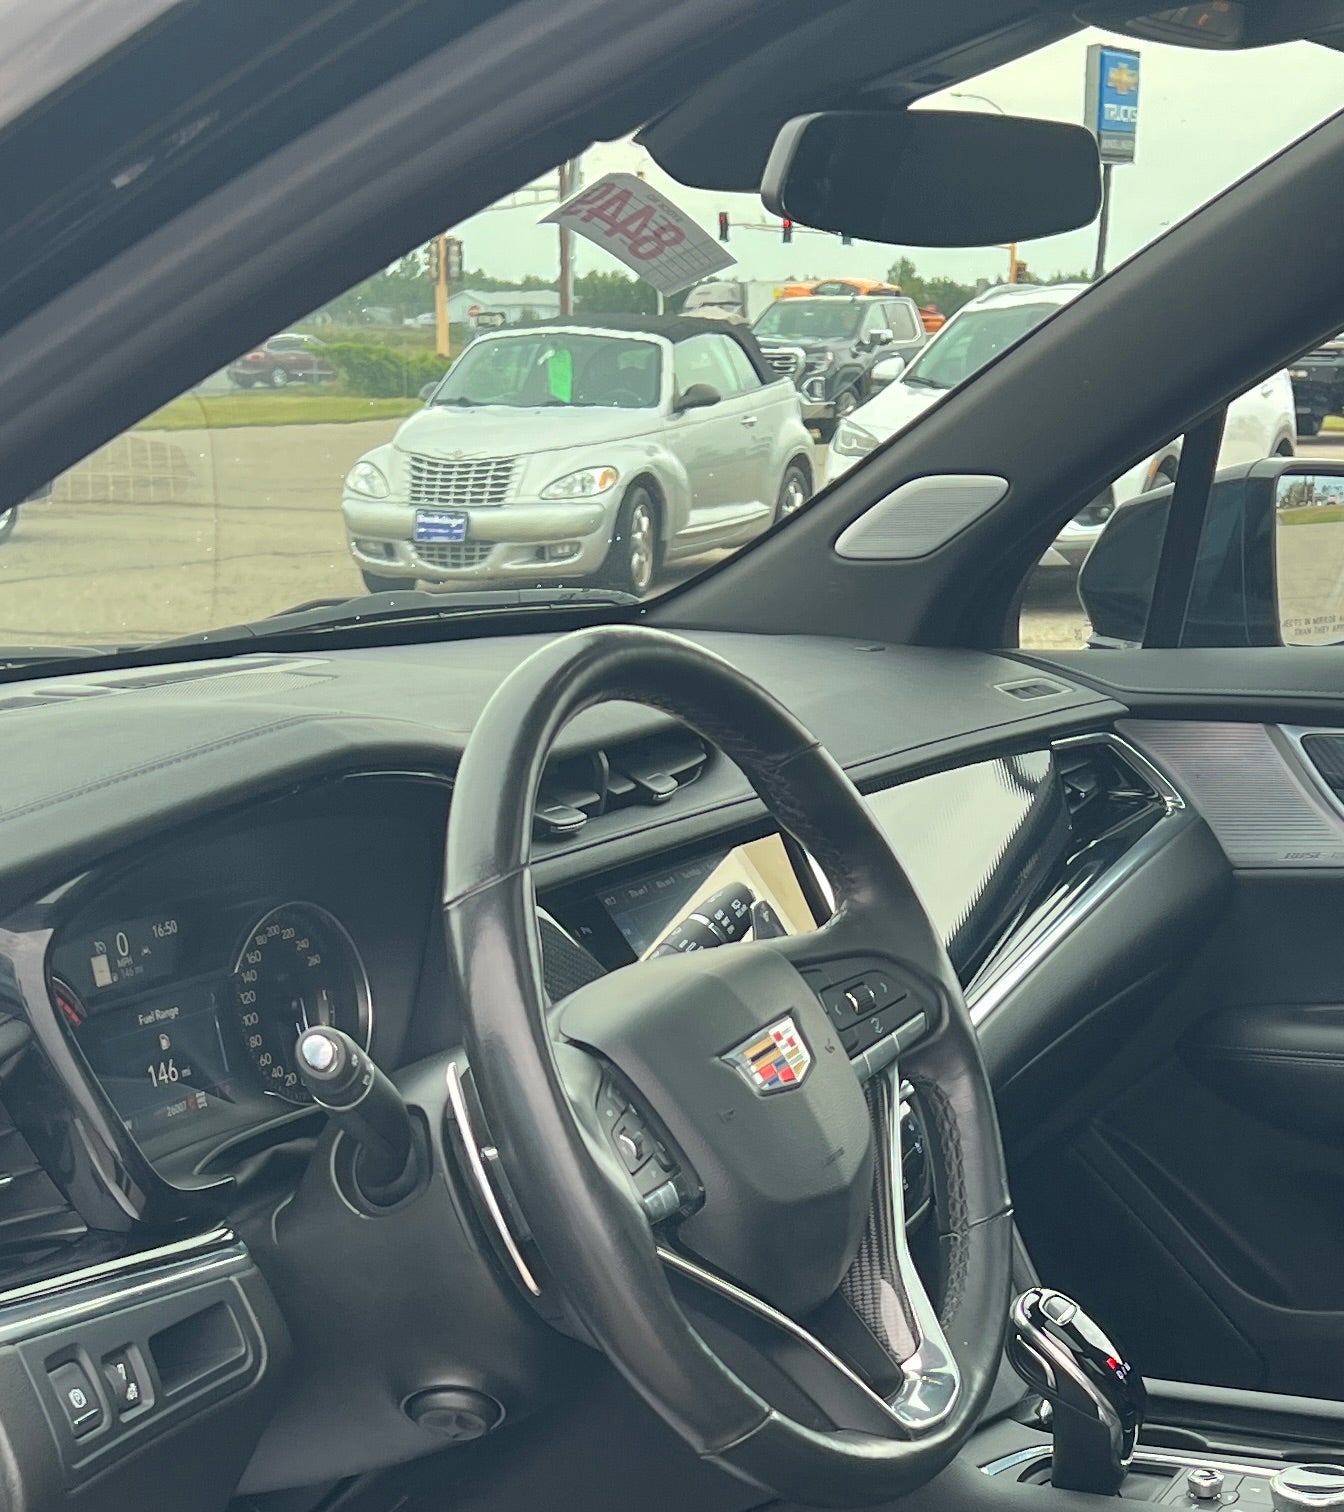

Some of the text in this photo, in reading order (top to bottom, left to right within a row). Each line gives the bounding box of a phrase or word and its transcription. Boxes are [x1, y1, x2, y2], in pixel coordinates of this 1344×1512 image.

[152, 919, 178, 938] 16:50
[265, 924, 281, 938] 200
[280, 927, 296, 940] 220
[116, 931, 129, 956] 0
[295, 938, 310, 951] 240
[246, 950, 262, 964] 160
[241, 969, 258, 984] 140
[240, 990, 256, 1005] 120
[138, 1006, 180, 1026] Fuel Range
[242, 1012, 260, 1027] 100
[248, 1034, 263, 1049] 80
[259, 1052, 273, 1067] 60
[147, 1058, 179, 1088] 146
[271, 1065, 285, 1079] 40
[284, 1073, 298, 1087] 20
